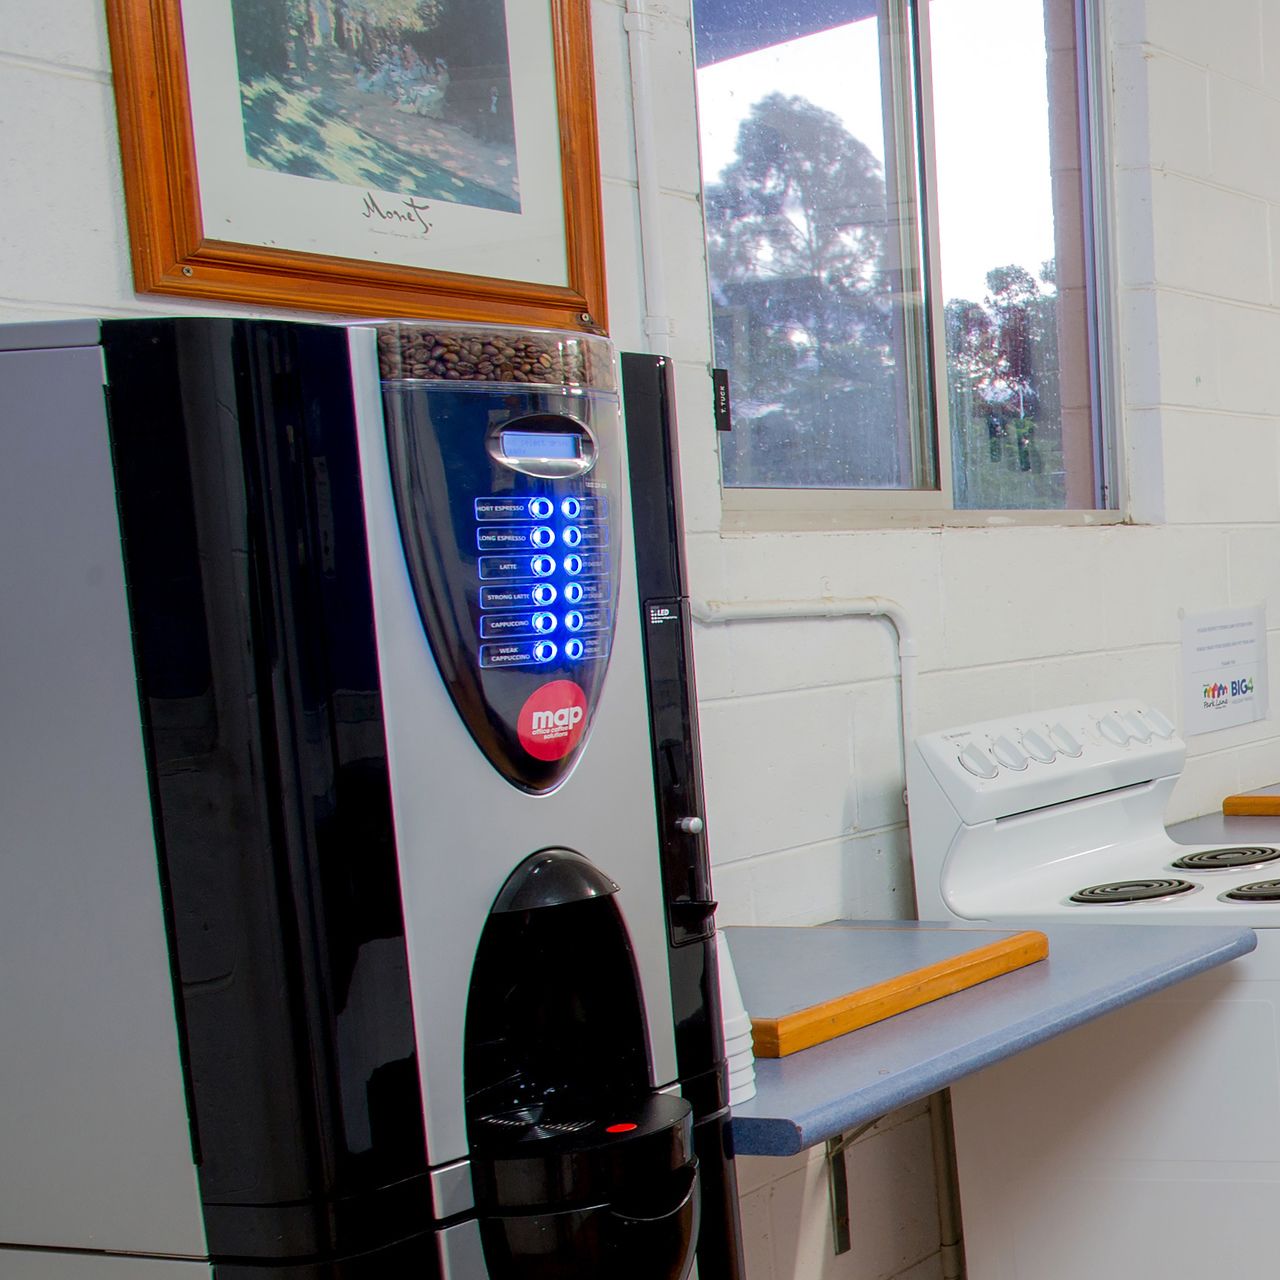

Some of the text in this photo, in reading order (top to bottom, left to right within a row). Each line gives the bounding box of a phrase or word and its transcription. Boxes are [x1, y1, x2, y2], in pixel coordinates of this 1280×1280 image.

[491, 620, 530, 628] CAPPUCCINO
[491, 654, 531, 662] CAPPUCCINO
[1231, 676, 1254, 697] BIG4
[531, 705, 583, 730] map
[531, 725, 569, 736] office coffee
[543, 731, 569, 740] solutions
